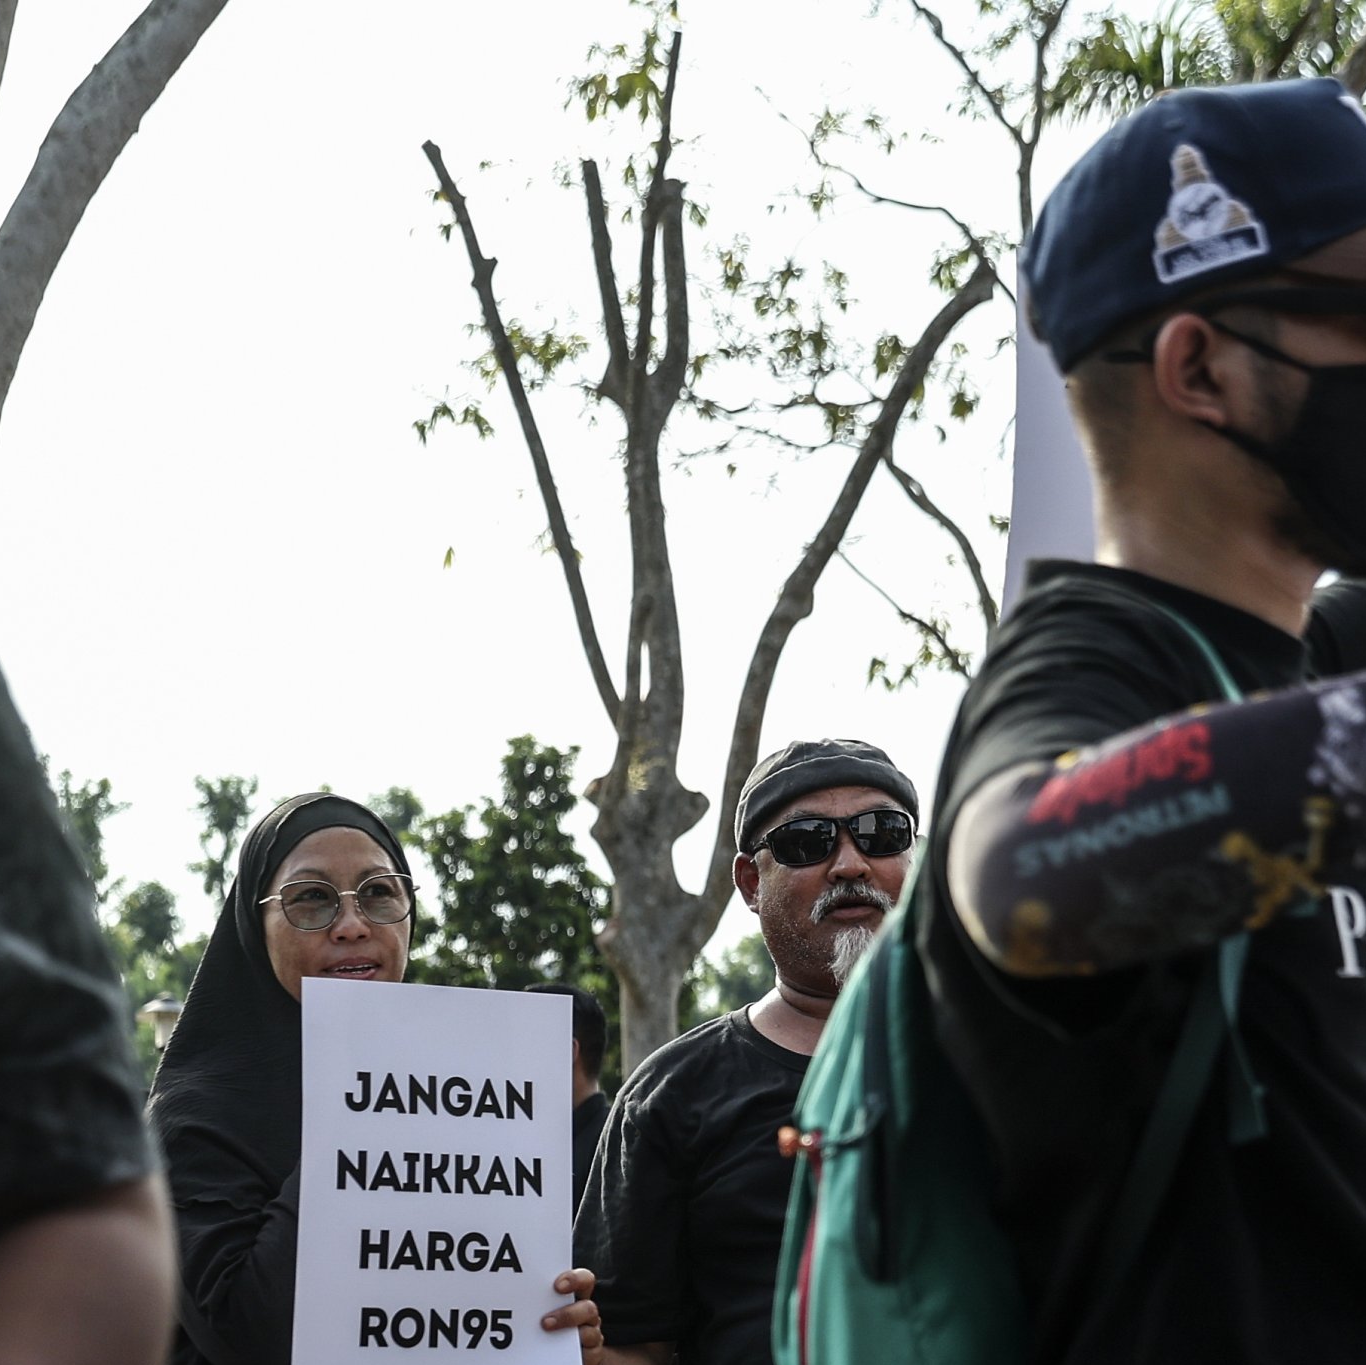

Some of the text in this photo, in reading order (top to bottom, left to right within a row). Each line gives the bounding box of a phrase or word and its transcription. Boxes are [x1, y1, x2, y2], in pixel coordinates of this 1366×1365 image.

[344, 1072, 534, 1120] JANGAN
[336, 1149, 542, 1198] NAIKKAN
[358, 1229, 523, 1273] HARGA
[358, 1307, 513, 1349] RON95
